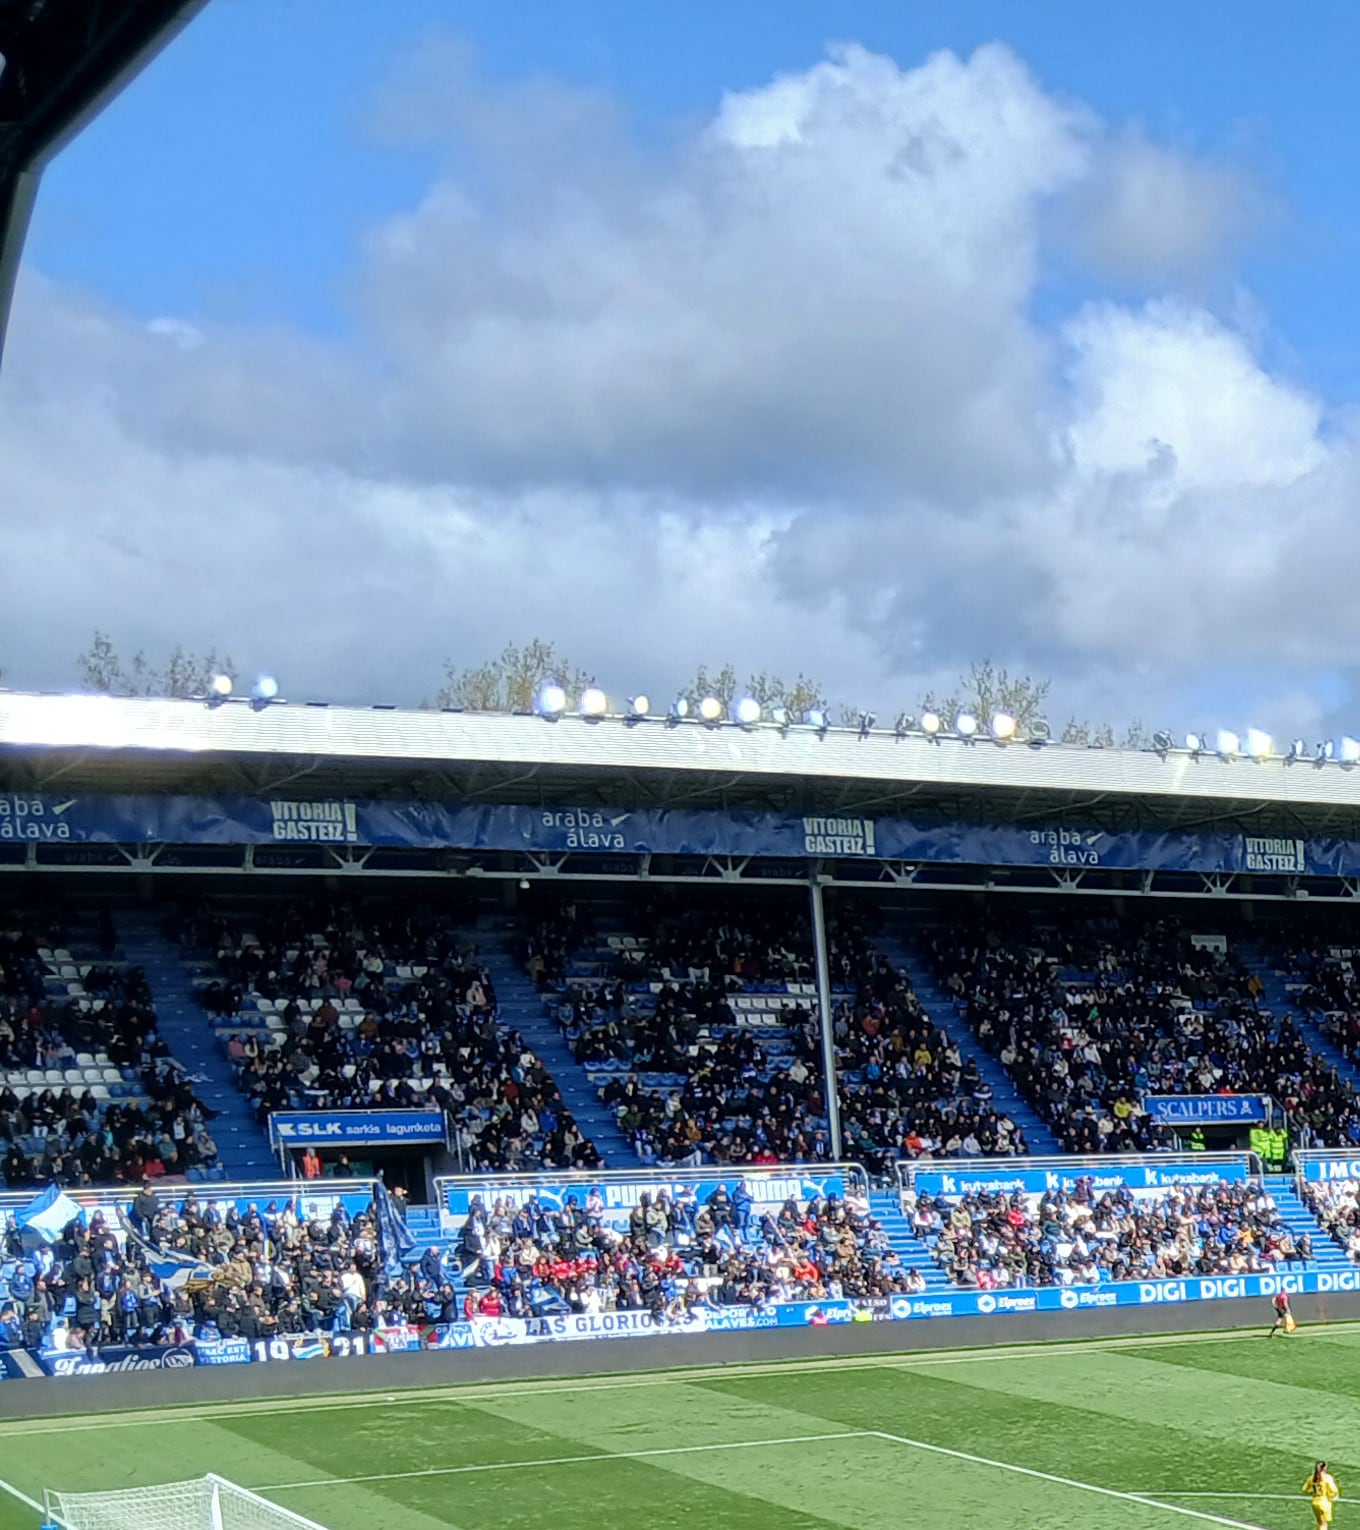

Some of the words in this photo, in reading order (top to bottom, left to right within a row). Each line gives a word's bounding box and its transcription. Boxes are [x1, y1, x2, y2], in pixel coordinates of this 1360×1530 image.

[270, 800, 343, 822] VITORIA
[542, 808, 603, 827] araba
[1, 818, 70, 839] álava
[273, 821, 345, 841] GASTEIZ
[802, 817, 863, 836] VITORIA
[1029, 828, 1081, 845] araba
[566, 829, 625, 848] álava
[804, 835, 865, 855] GASTEIZ
[1246, 837, 1295, 855] VITORIA
[1050, 846, 1098, 865] álava
[1157, 1100, 1237, 1117] SCALPERS
[297, 1122, 343, 1136] SLK
[748, 1180, 802, 1202] UMA
[1063, 1175, 1123, 1188] kubank
[1200, 1278, 1246, 1299] DIGI
[1259, 1275, 1304, 1296] DIGI
[1317, 1272, 1360, 1292] DIGI
[1139, 1282, 1187, 1304] DIGI
[525, 1316, 567, 1337] LAS
[576, 1311, 693, 1334] GLORIOS
